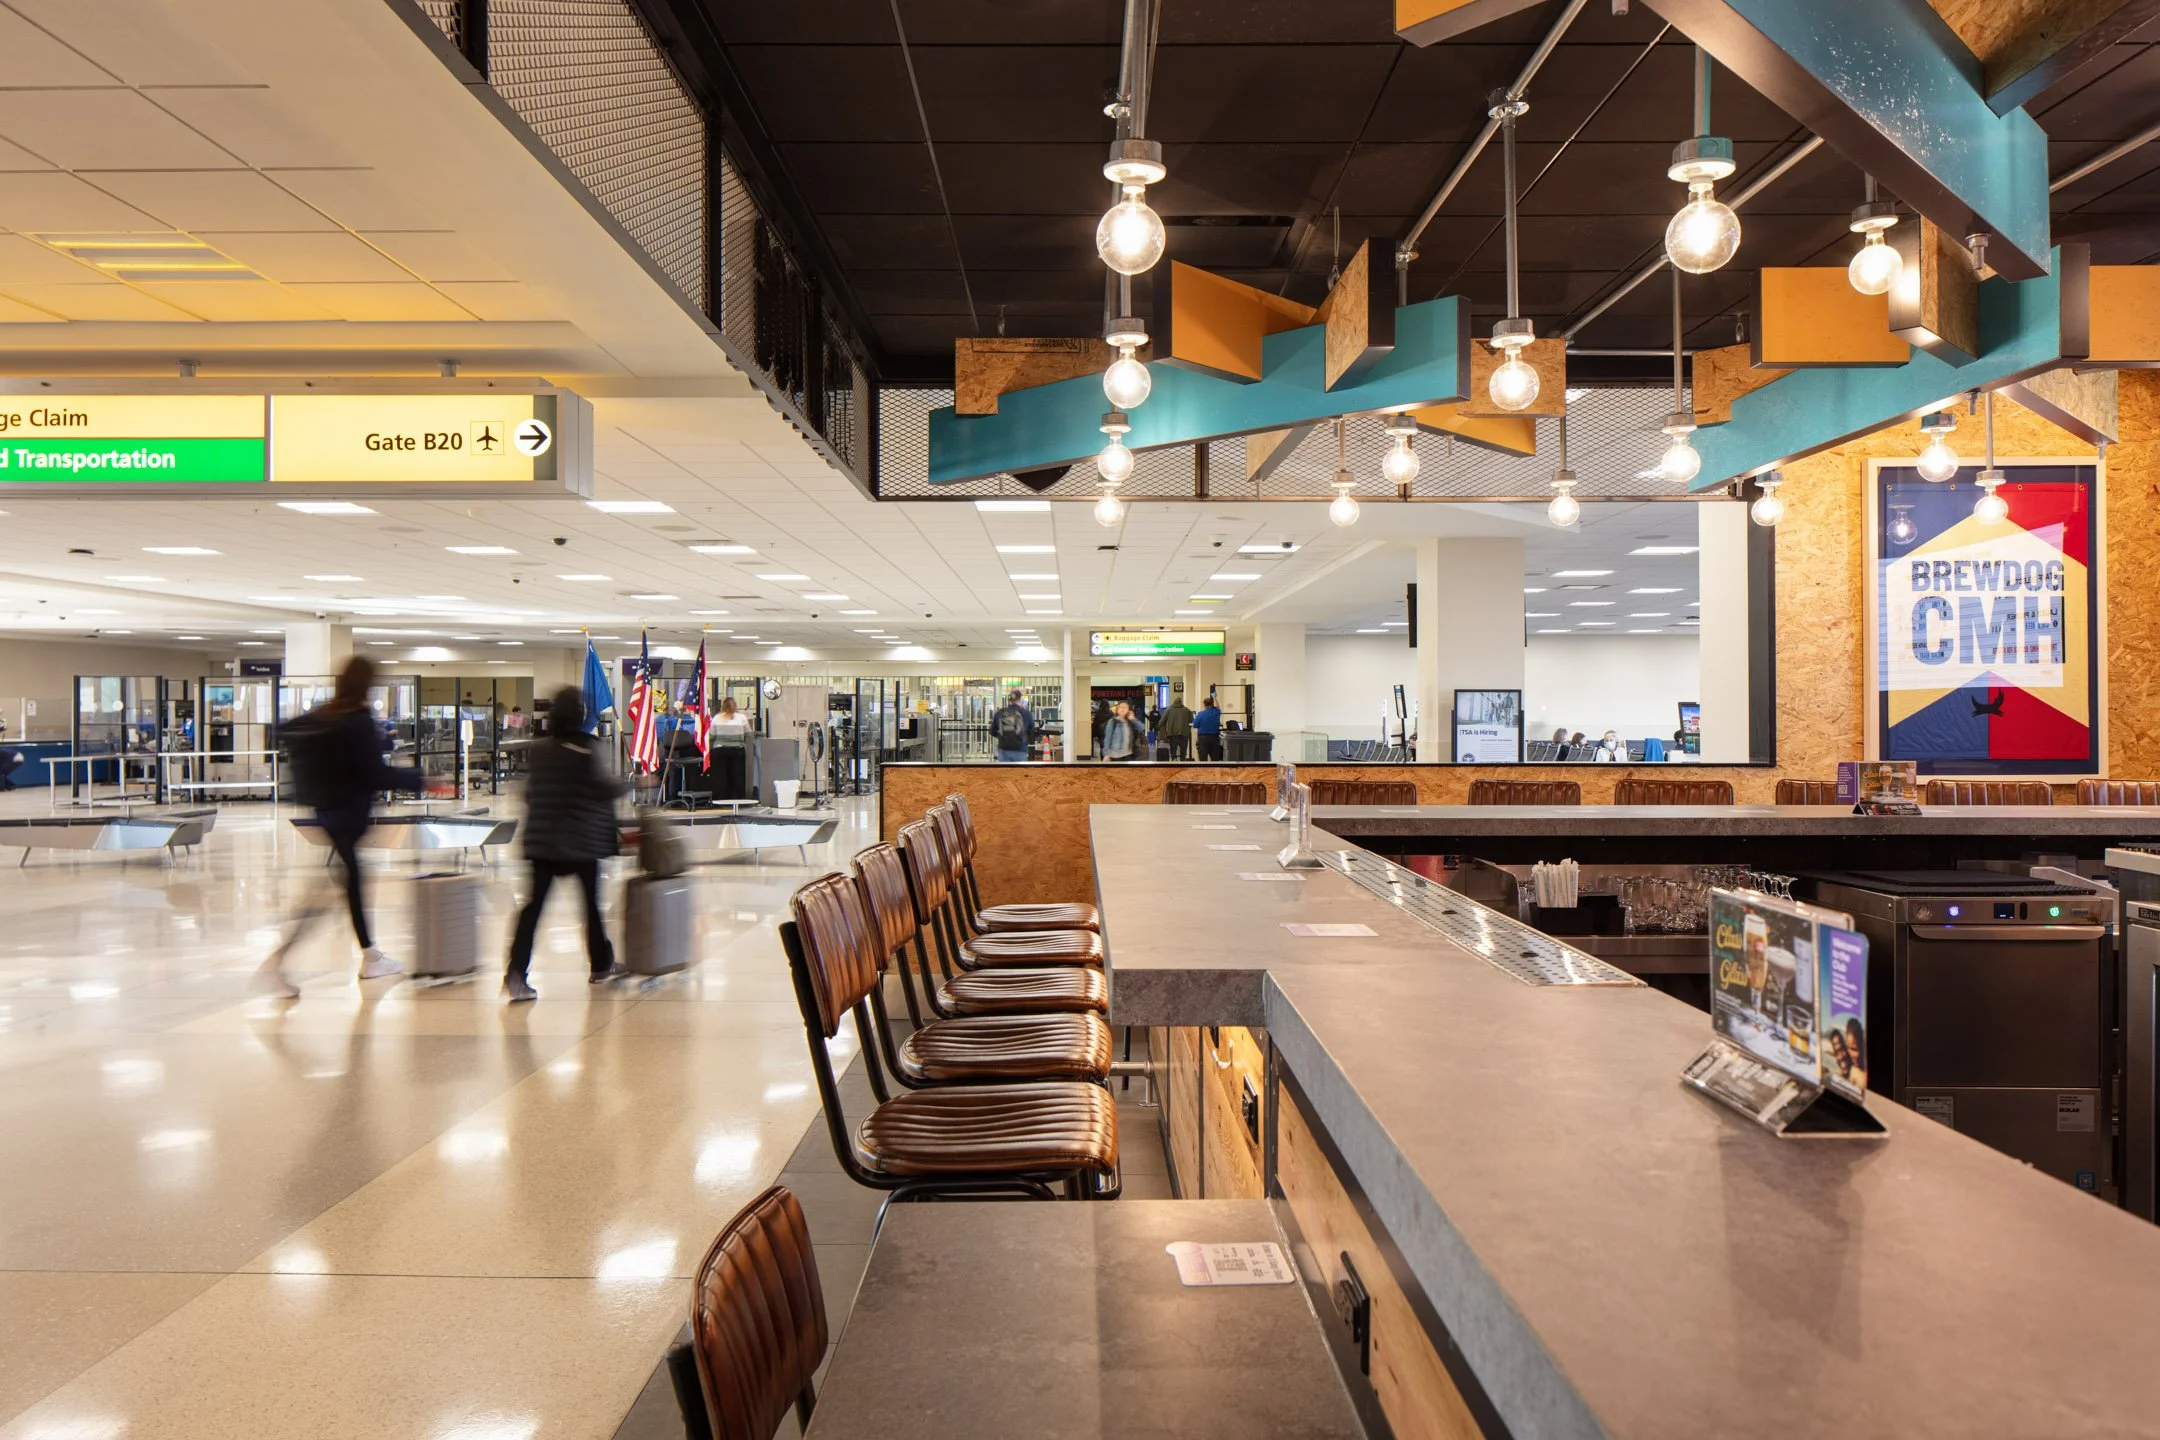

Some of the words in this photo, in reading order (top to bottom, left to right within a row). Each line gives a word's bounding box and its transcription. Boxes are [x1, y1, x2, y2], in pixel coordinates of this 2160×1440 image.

[30, 408, 88, 427] Claim
[365, 433, 416, 451] Gate
[424, 432, 463, 450] B20
[14, 447, 176, 473] Transportation
[1911, 560, 2064, 592] BREWDOG
[1911, 595, 2065, 665] CMH
[1480, 729, 1498, 737] Hiring
